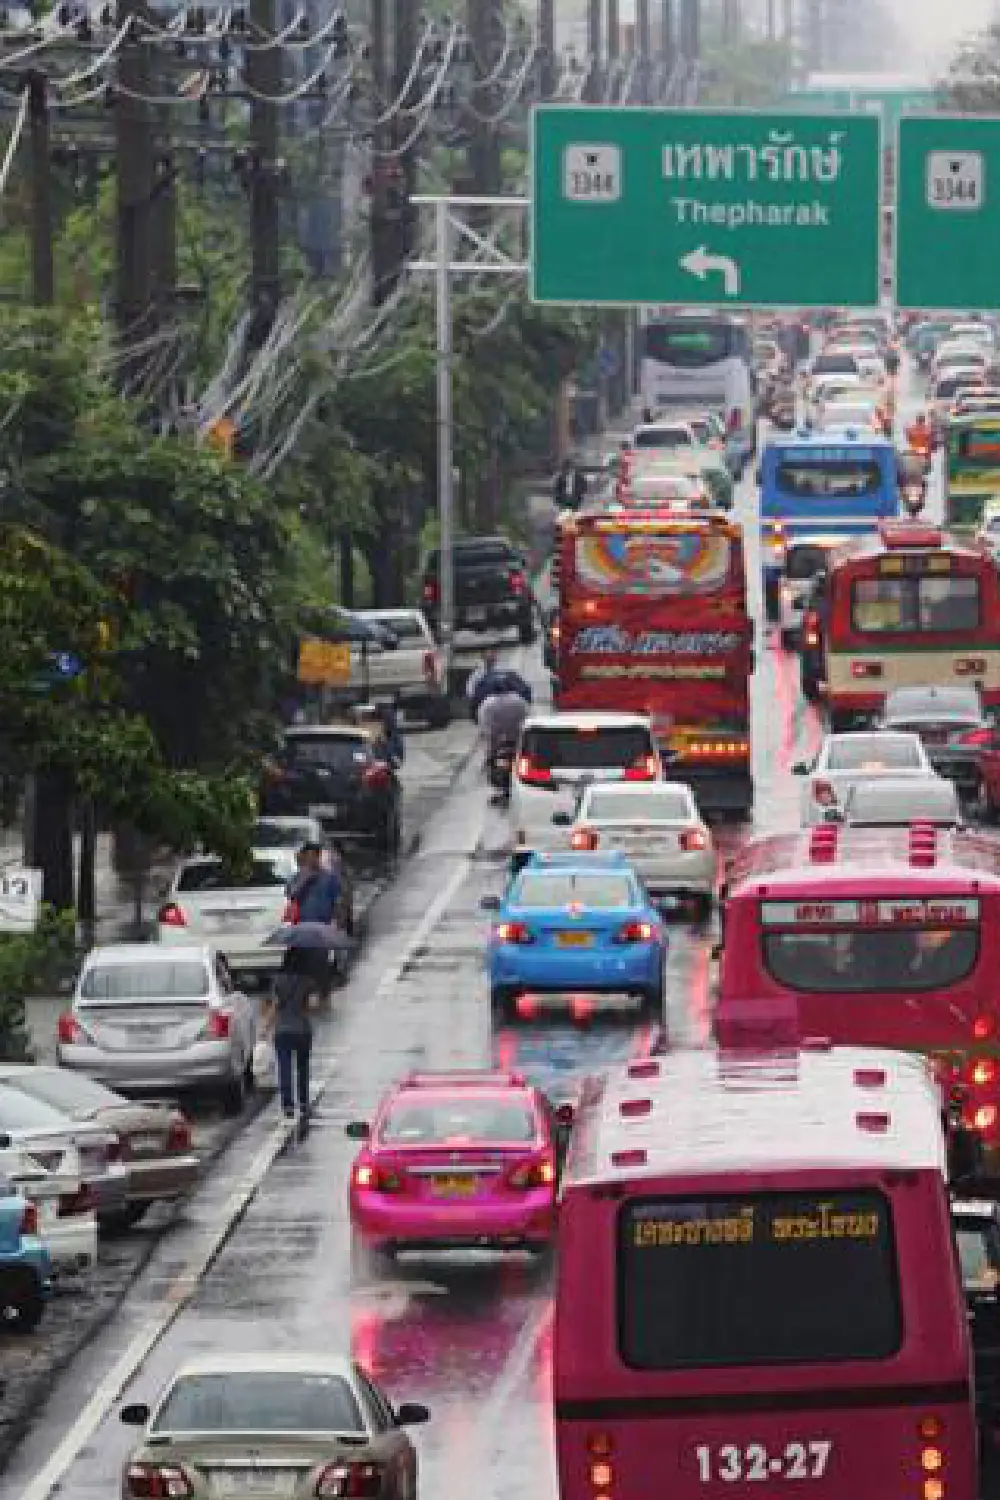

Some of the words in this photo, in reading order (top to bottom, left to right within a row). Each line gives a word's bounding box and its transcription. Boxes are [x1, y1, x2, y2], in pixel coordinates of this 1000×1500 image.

[660, 129, 848, 181] เทพารักษ์
[671, 197, 830, 230] Thepharak
[696, 1440, 833, 1483] 132-27
